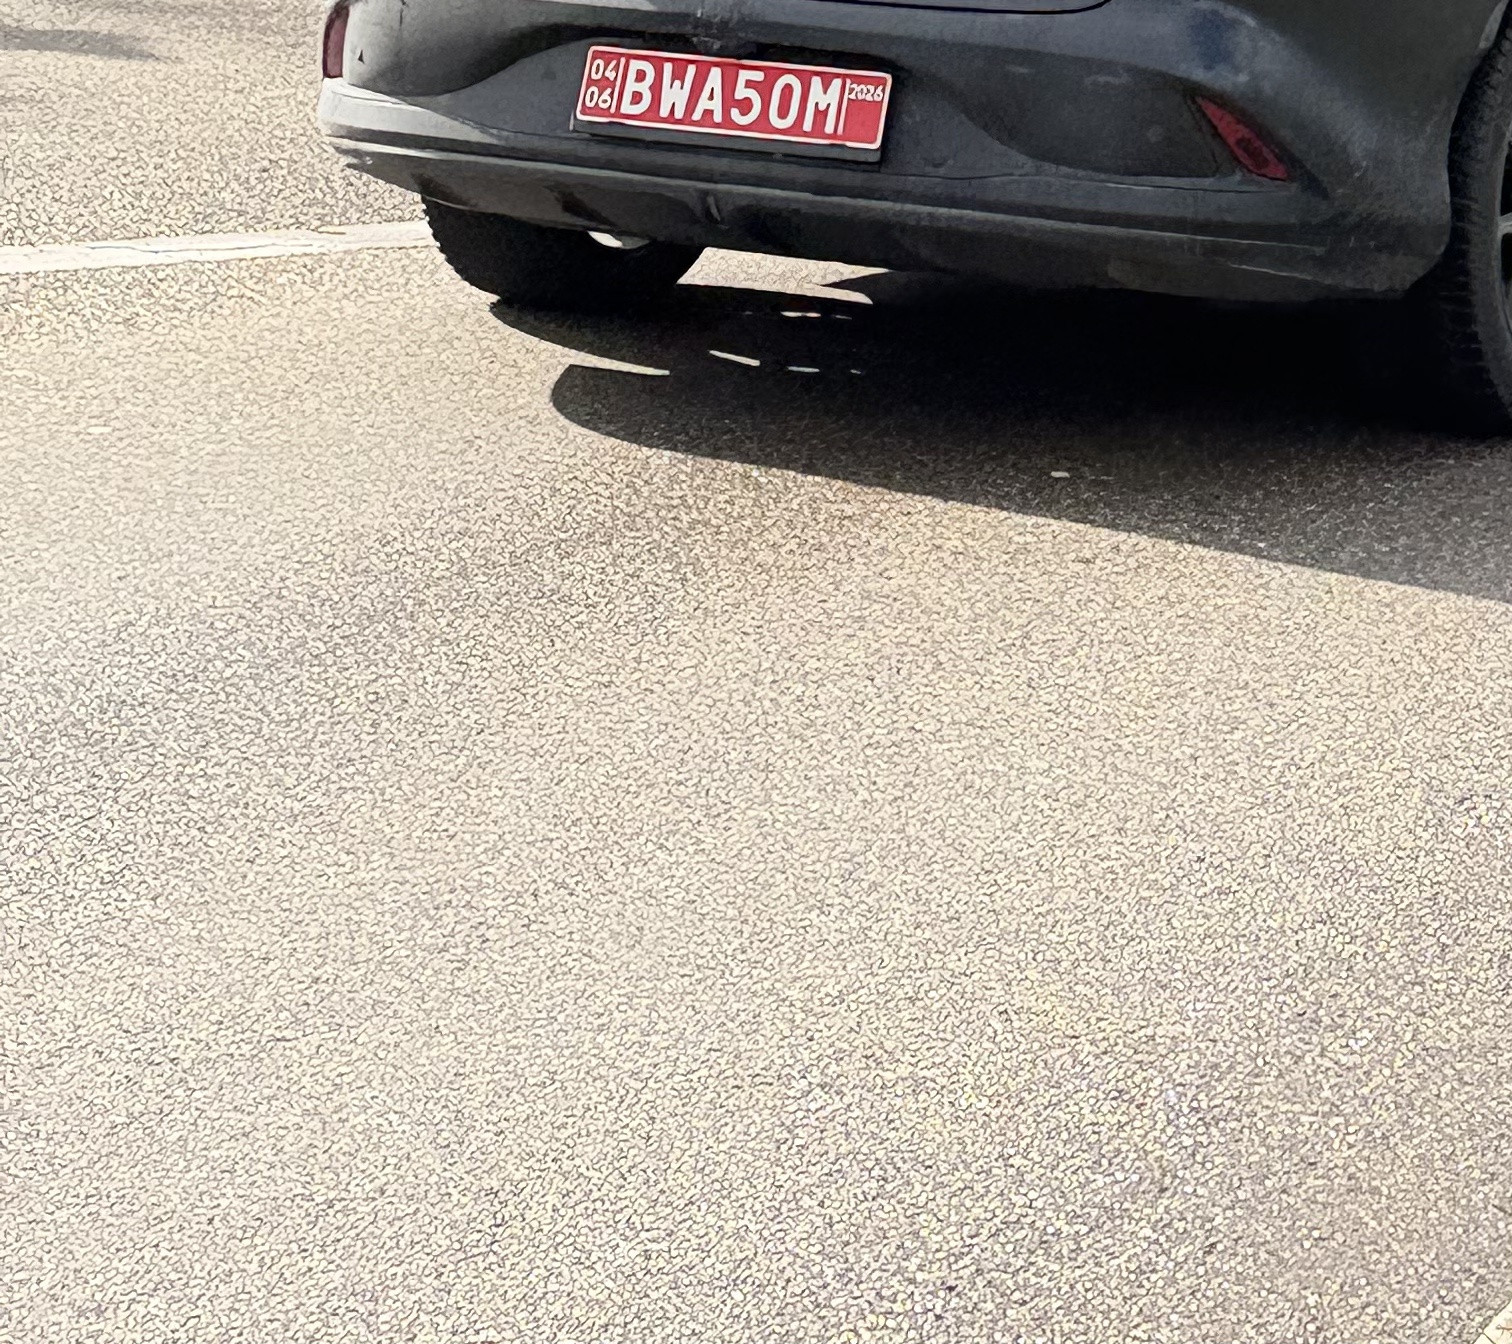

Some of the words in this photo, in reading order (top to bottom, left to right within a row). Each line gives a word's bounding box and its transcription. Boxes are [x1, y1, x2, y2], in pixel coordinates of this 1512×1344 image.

[590, 58, 617, 82] 04
[584, 85, 613, 110] 06
[619, 58, 843, 135] BWA50M
